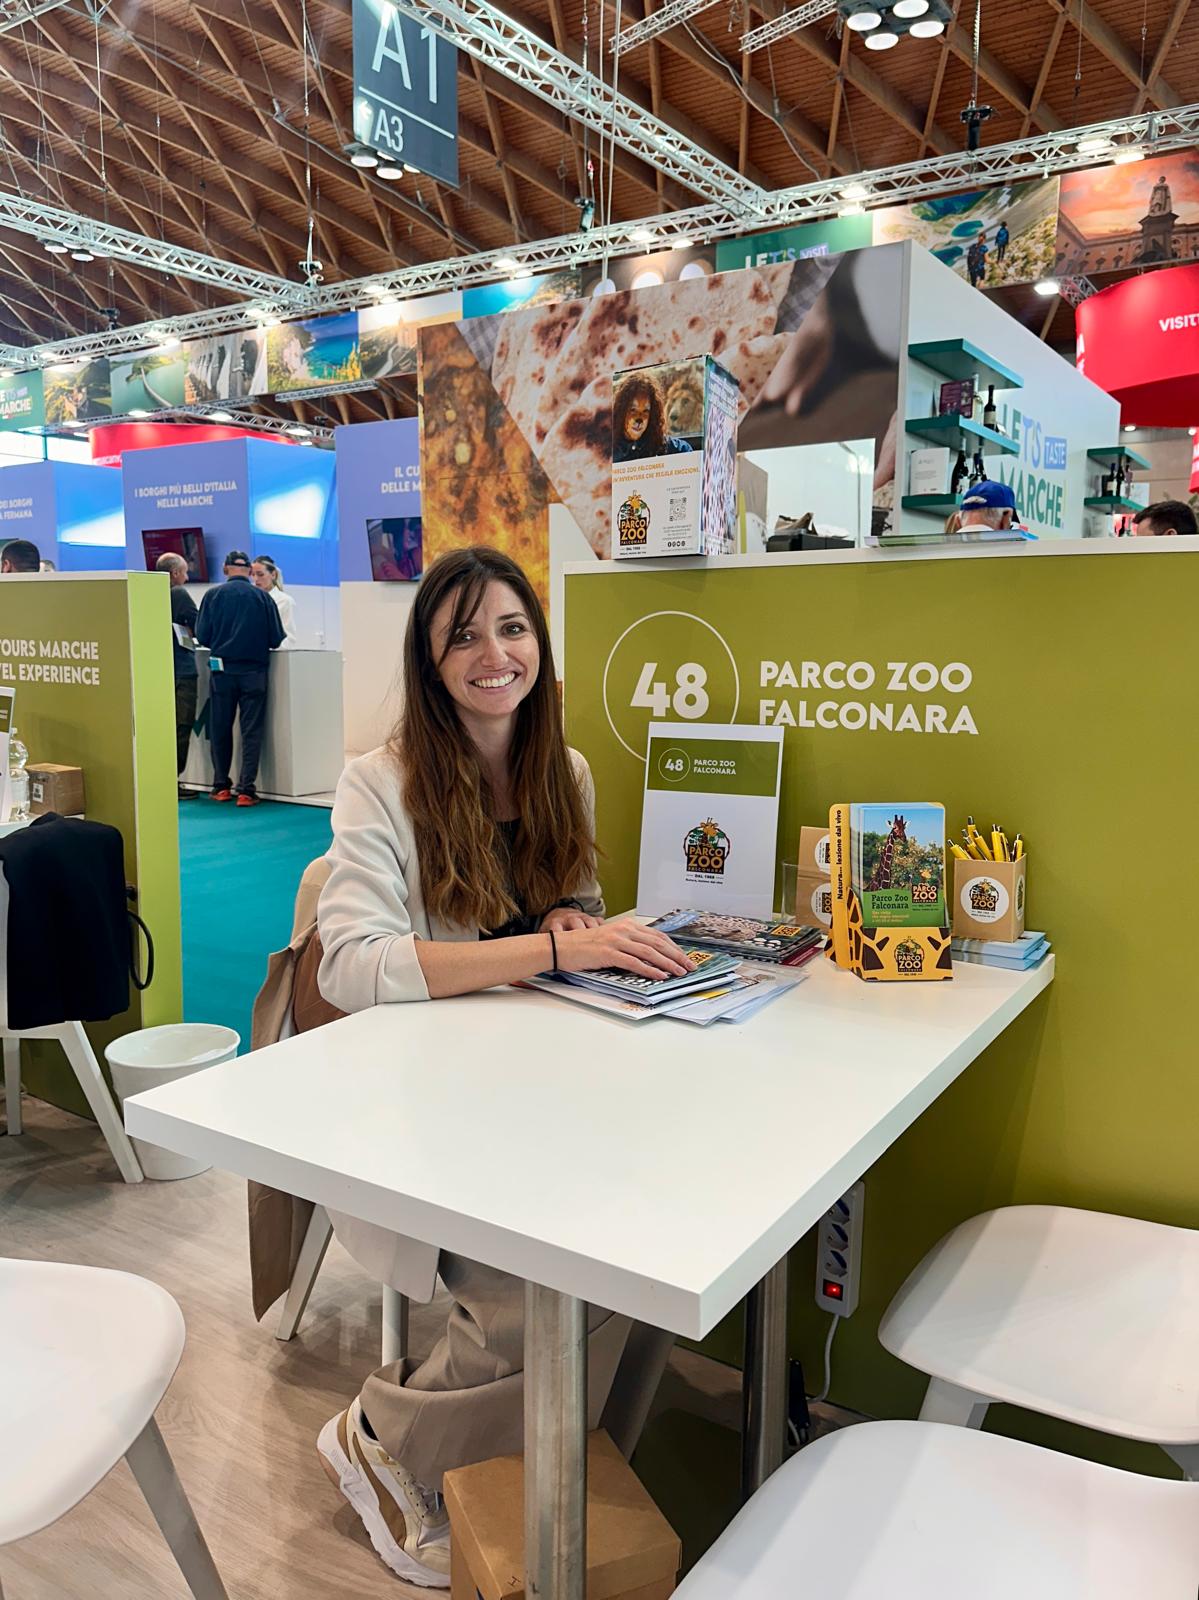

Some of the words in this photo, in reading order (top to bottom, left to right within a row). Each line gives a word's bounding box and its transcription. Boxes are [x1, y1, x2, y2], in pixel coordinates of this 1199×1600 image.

[372, 3, 437, 104] A1
[374, 109, 404, 152] A3
[1045, 440, 1066, 466] TASTE
[394, 466, 404, 478] IL
[139, 486, 167, 498] BORGHI
[169, 482, 181, 496] PIÙ
[183, 483, 202, 494] BELLI
[204, 480, 237, 493] D'ITALIA
[381, 481, 410, 493] DELLE
[157, 498, 179, 509] NELLE
[180, 495, 214, 507] MARCHE
[621, 519, 646, 529] PARCO
[621, 528, 646, 540] ZOO
[0, 639, 36, 657] OURS
[40, 640, 99, 660] MARCHE
[19, 663, 100, 685] EXPERIENCE
[759, 661, 875, 690] PARCO
[886, 662, 973, 693] ZOO
[630, 662, 710, 720] 48
[759, 699, 979, 735] FALCONARA
[665, 758, 684, 771] 48
[694, 759, 718, 767] PARCO
[693, 767, 736, 775] FALCONARA
[689, 846, 723, 857] PARCO
[688, 855, 723, 869] ZOO
[913, 891, 937, 900] ZOO
[974, 900, 995, 908] ZOO
[899, 960, 921, 969] ZOO
